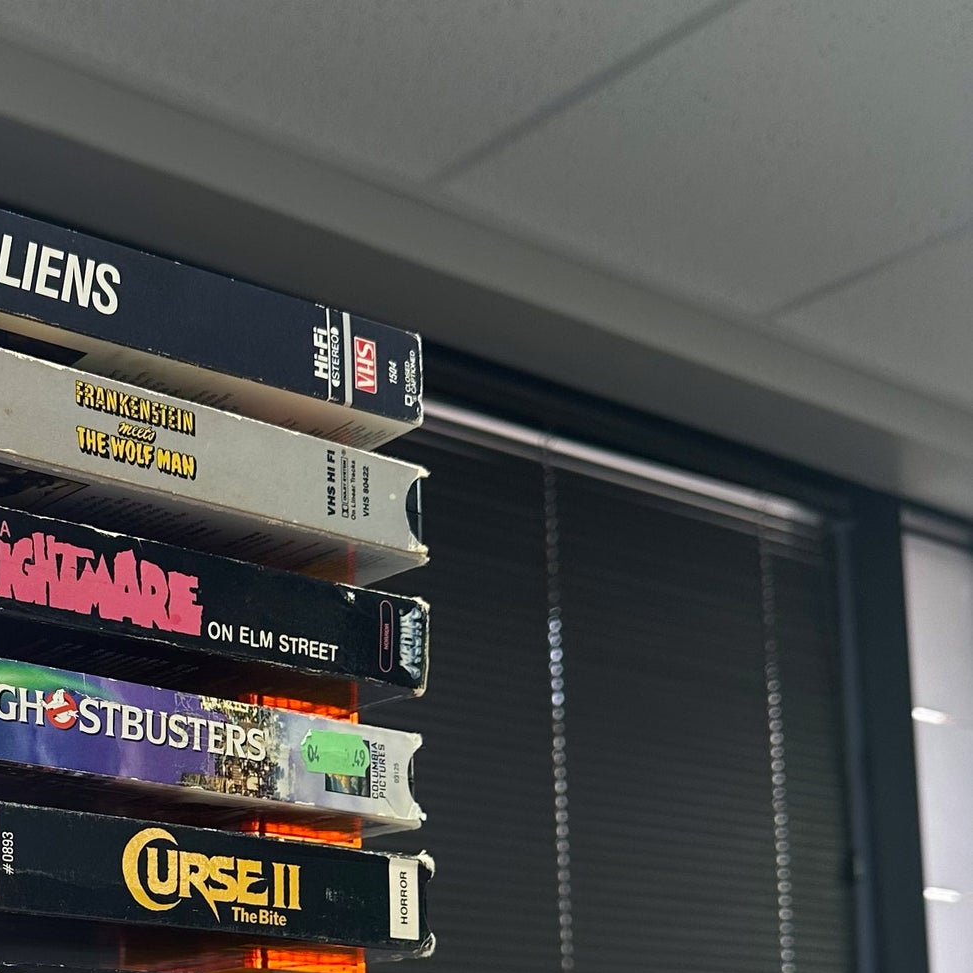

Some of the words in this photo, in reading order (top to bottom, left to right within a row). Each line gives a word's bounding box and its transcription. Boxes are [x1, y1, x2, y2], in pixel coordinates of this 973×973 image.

[313, 326, 329, 380] Hi-Fi
[330, 332, 341, 382] STEREO
[356, 339, 376, 389] VHS
[388, 360, 398, 385] 1504
[409, 350, 417, 394] CAPTIONED
[75, 379, 195, 437] FRANKENSTEIN
[76, 425, 110, 460] THE
[110, 434, 155, 469] WOLF
[156, 447, 197, 481] MAN
[117, 421, 156, 444] meets
[327, 449, 336, 464] FI
[327, 467, 336, 483] HI
[327, 486, 336, 516] VHS
[362, 466, 370, 495] 80422
[350, 512, 357, 521] On
[362, 496, 370, 517] VHS
[0, 521, 10, 539] A
[208, 621, 233, 643] ON
[239, 625, 273, 649] ELM
[279, 634, 339, 662] STREET
[371, 742, 379, 800] COLUMBIA
[377, 744, 387, 799] PICTURES
[1, 831, 15, 875] #0893
[122, 827, 269, 923] CURSE
[271, 862, 303, 911] II
[231, 906, 258, 925] The
[258, 909, 288, 927] Bite
[399, 870, 409, 925] HORROR
